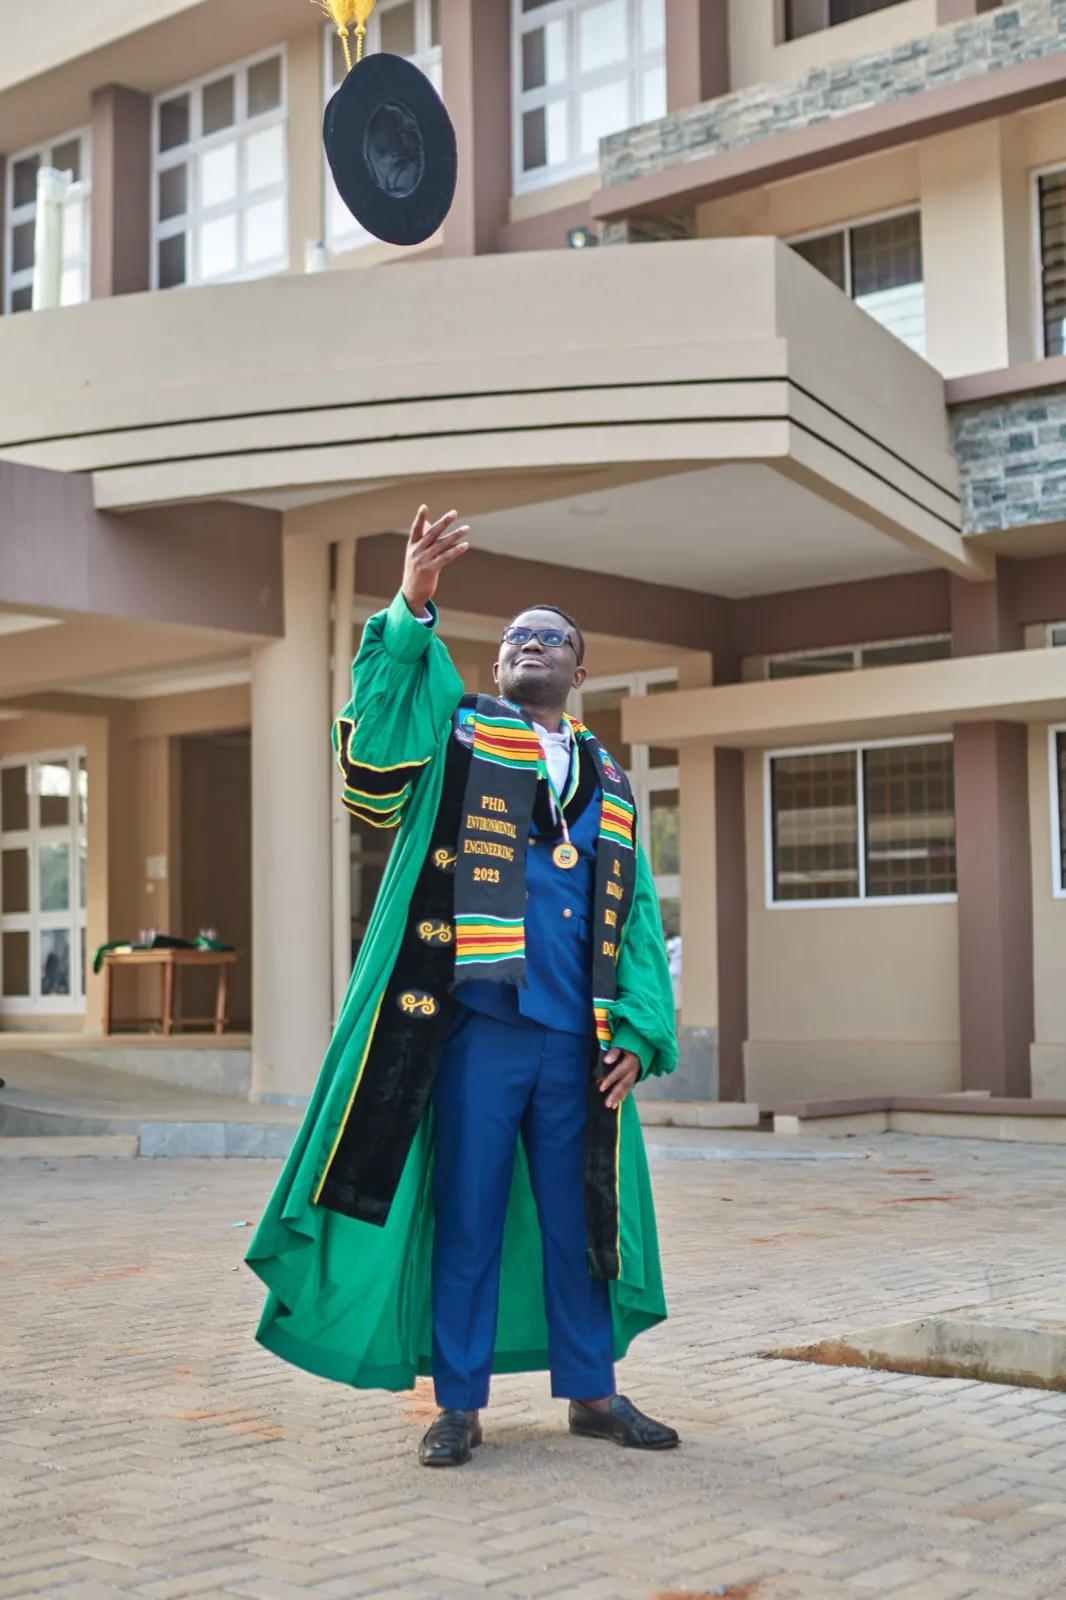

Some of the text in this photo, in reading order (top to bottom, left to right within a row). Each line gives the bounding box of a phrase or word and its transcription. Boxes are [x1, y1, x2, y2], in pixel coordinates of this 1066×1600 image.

[481, 795, 508, 813] PHD.
[466, 815, 517, 839] ENVIRONMENTAL
[464, 840, 514, 862] ENGINEERING
[473, 867, 500, 883] 2023
